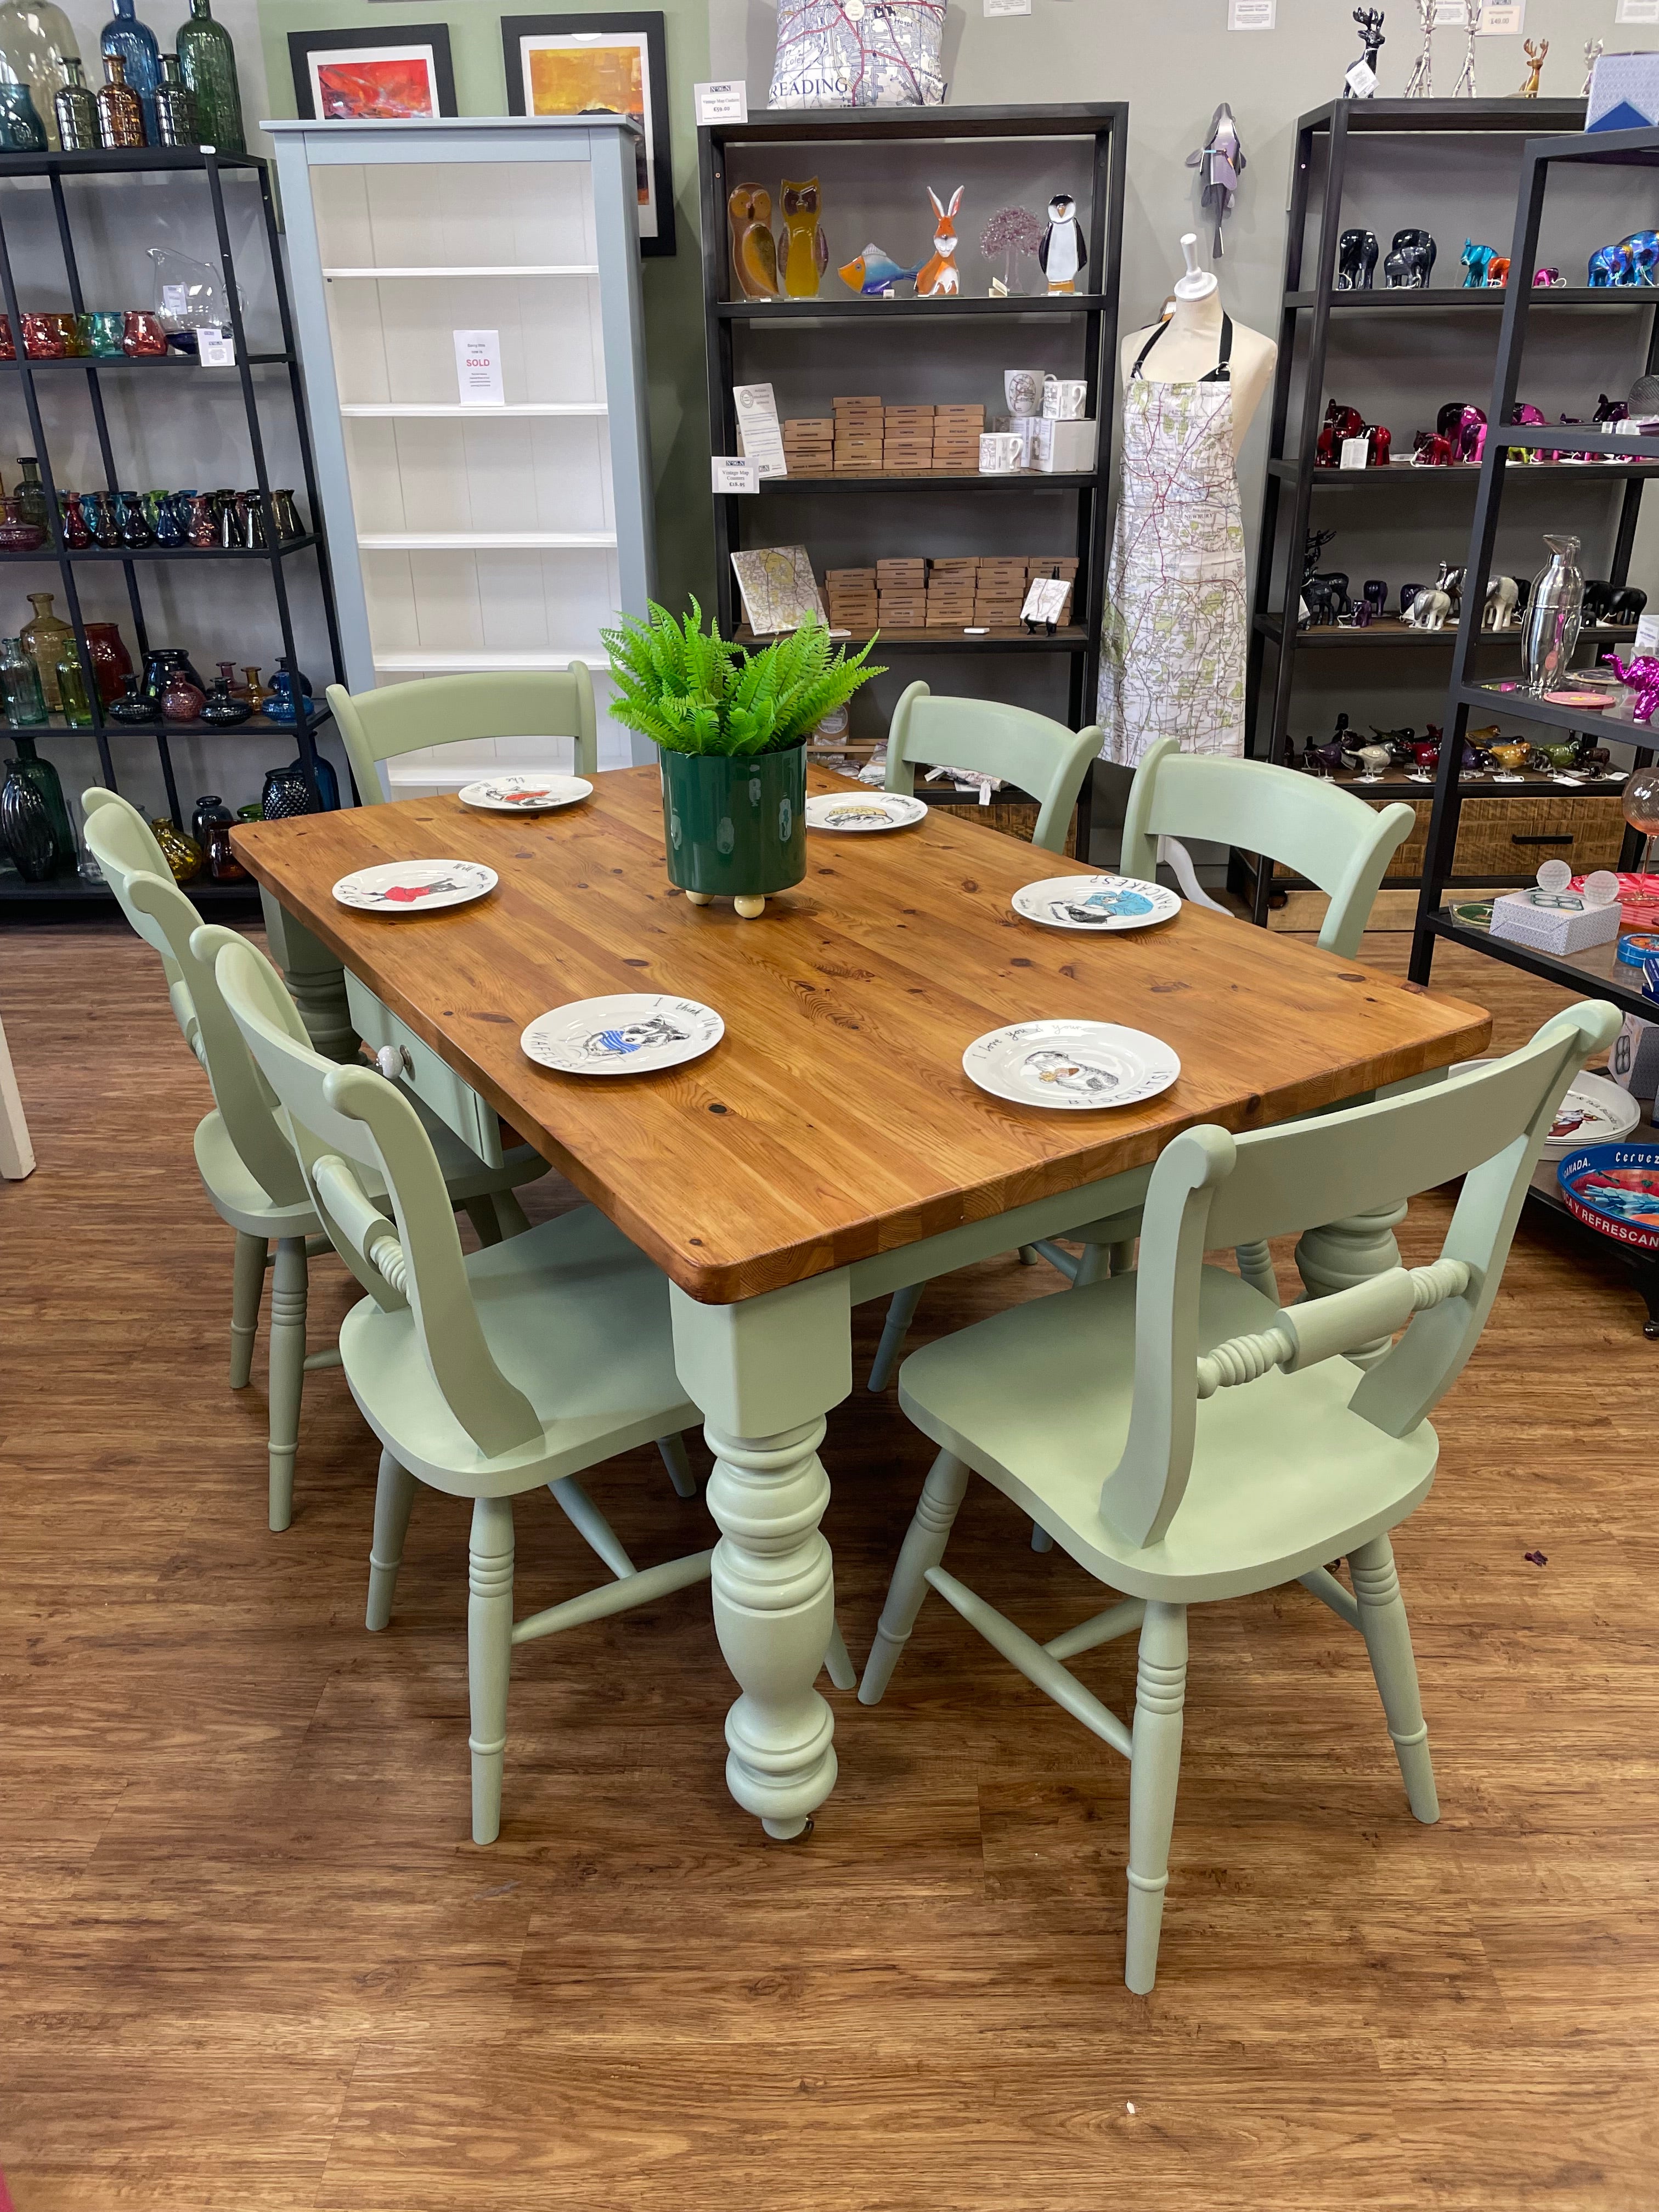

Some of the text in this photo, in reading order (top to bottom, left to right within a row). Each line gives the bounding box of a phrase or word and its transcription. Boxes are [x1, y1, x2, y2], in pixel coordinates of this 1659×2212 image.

[785, 56, 805, 66] Coley
[770, 77, 848, 98] READING
[453, 863, 476, 871] Will
[1090, 875, 1173, 910] PANCAKES?
[653, 997, 664, 1007] I
[675, 1002, 705, 1017] think
[1005, 1028, 1026, 1041] you
[1051, 1025, 1082, 1035] your
[1068, 1070, 1173, 1105] BISCUITS!
[1563, 1157, 1591, 1179] CANADA.
[1575, 1202, 1579, 1214] Y
[1582, 1209, 1659, 1248] REFRESCAN
